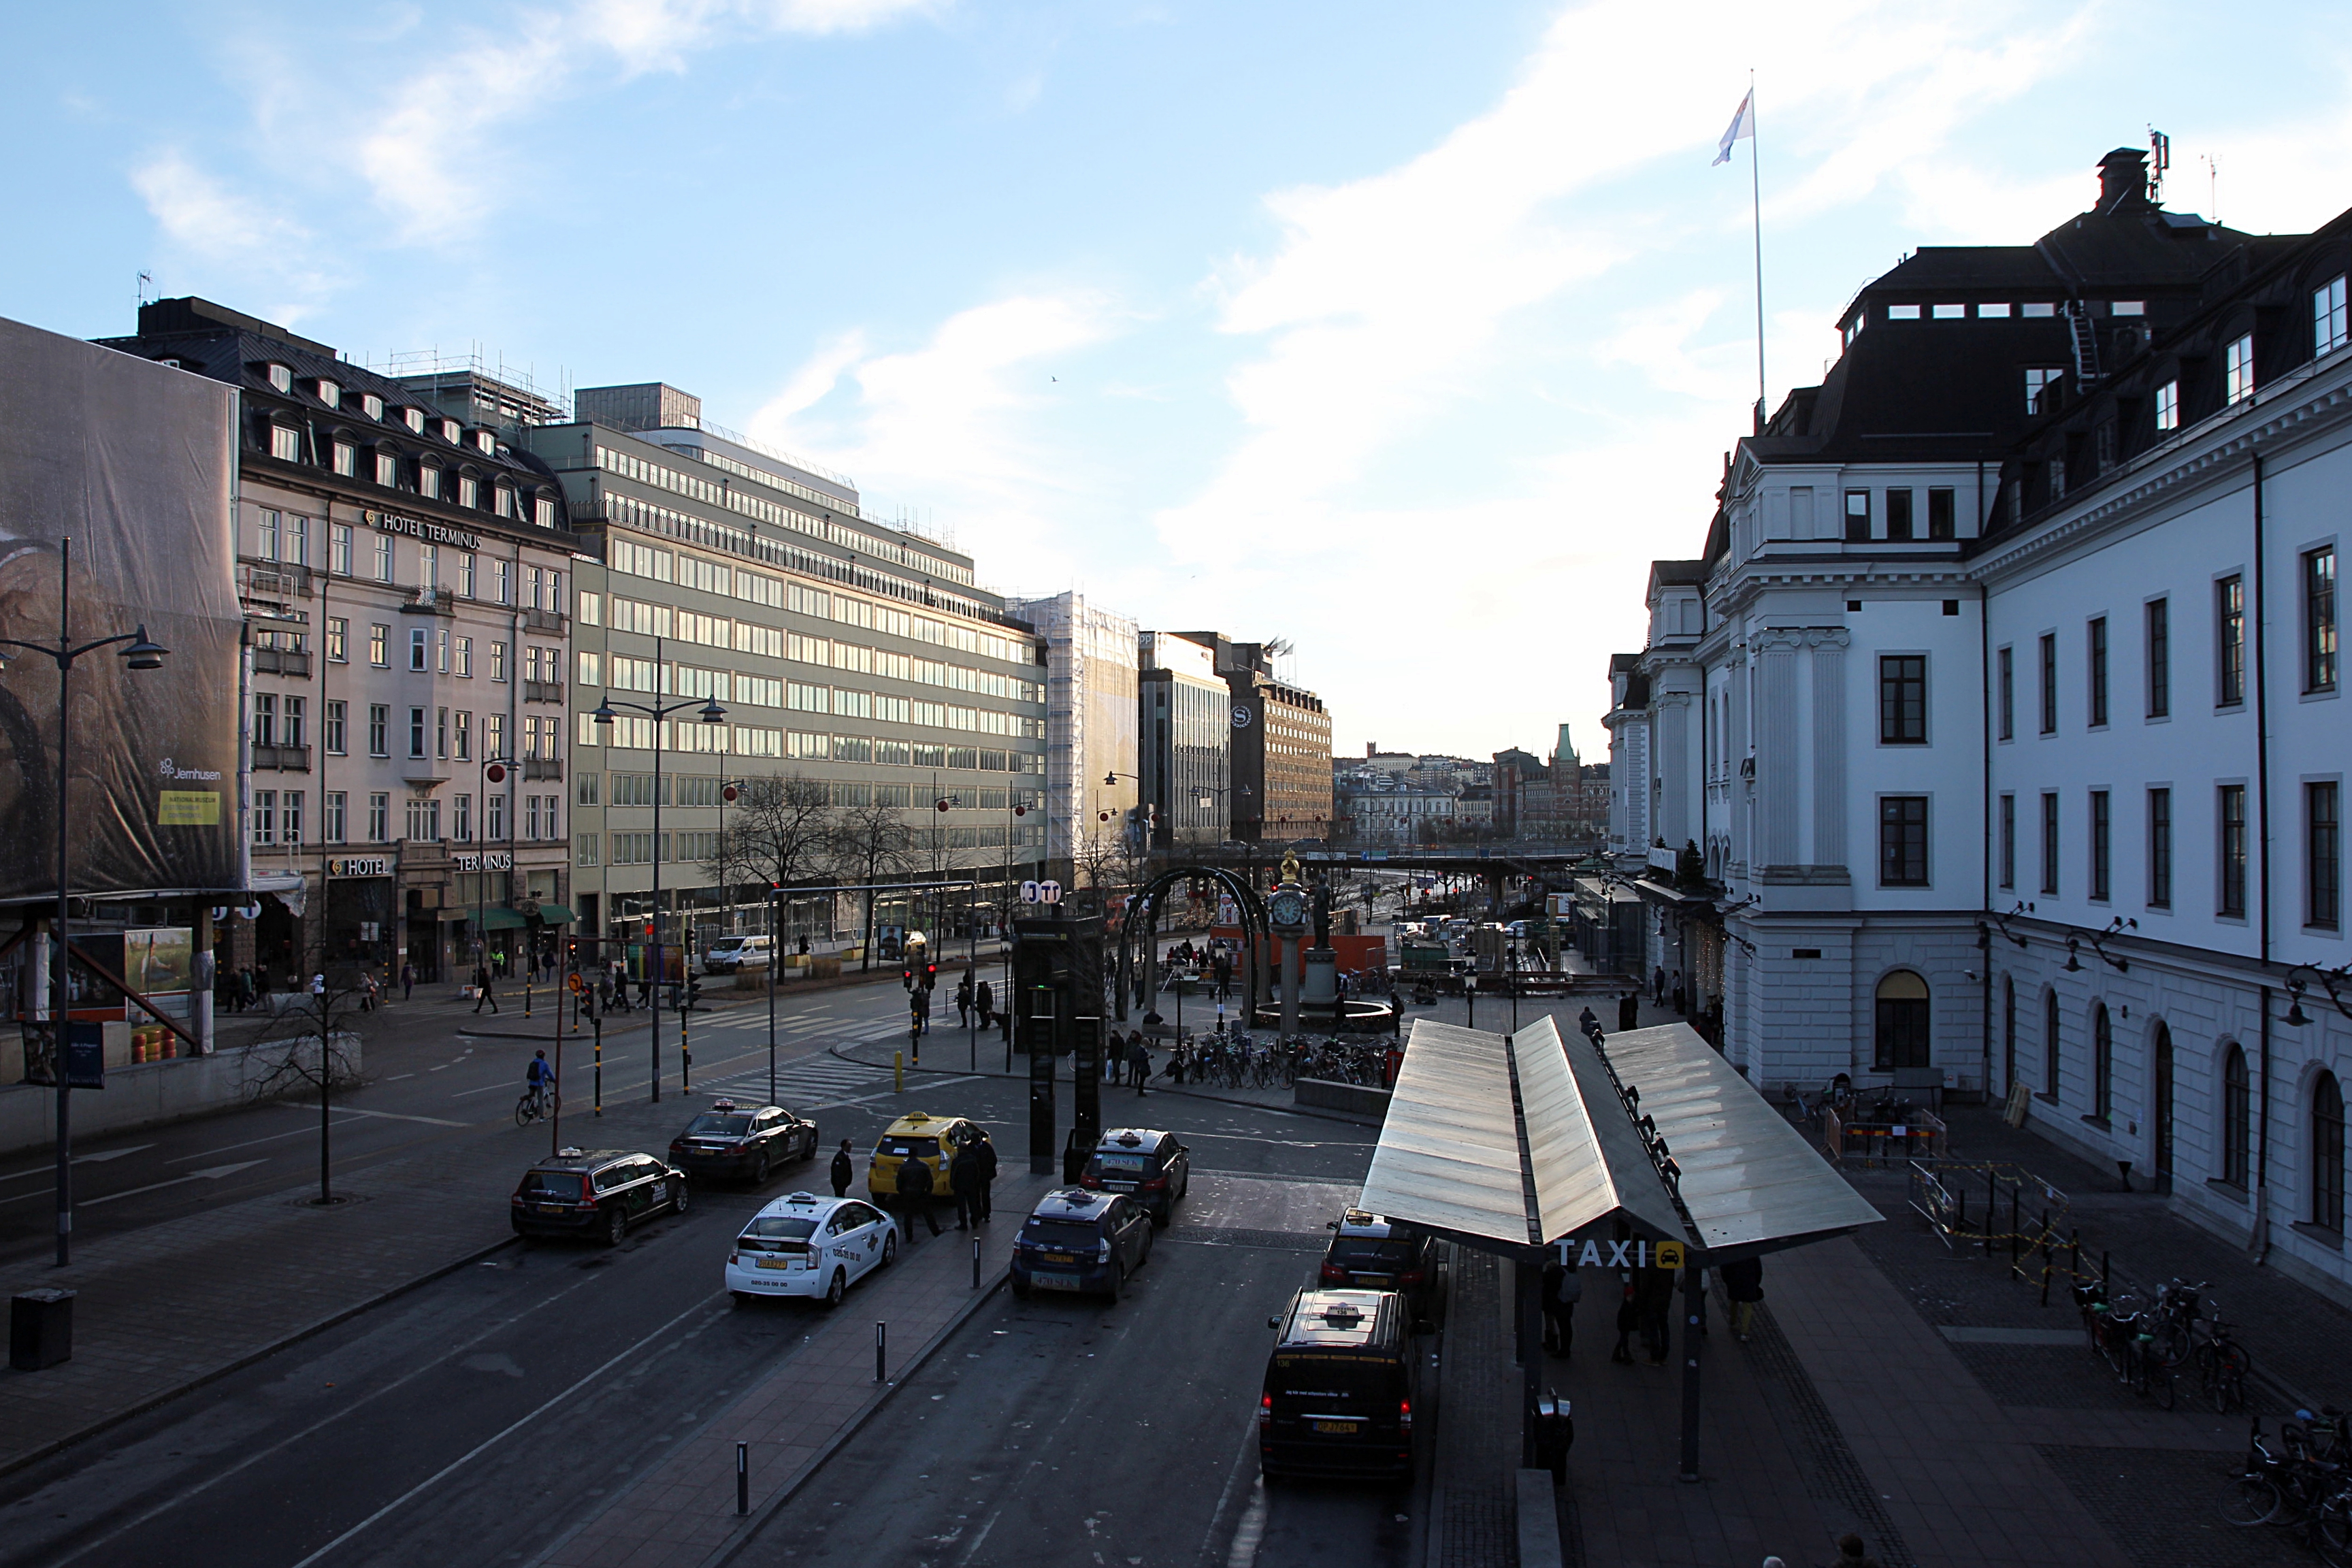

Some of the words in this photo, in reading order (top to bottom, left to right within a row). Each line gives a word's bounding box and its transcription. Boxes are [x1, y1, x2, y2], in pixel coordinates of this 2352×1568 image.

[384, 514, 423, 536] HOTEL
[426, 524, 482, 549] TERMINUS
[1234, 709, 1246, 723] S
[174, 768, 220, 780] Jernhusen
[348, 859, 389, 875] HOTEL
[457, 854, 510, 871] TERMINUS
[1554, 1239, 1646, 1268] TAXI
[1037, 1277, 1053, 1286] 470
[1277, 1360, 1290, 1368] 136
